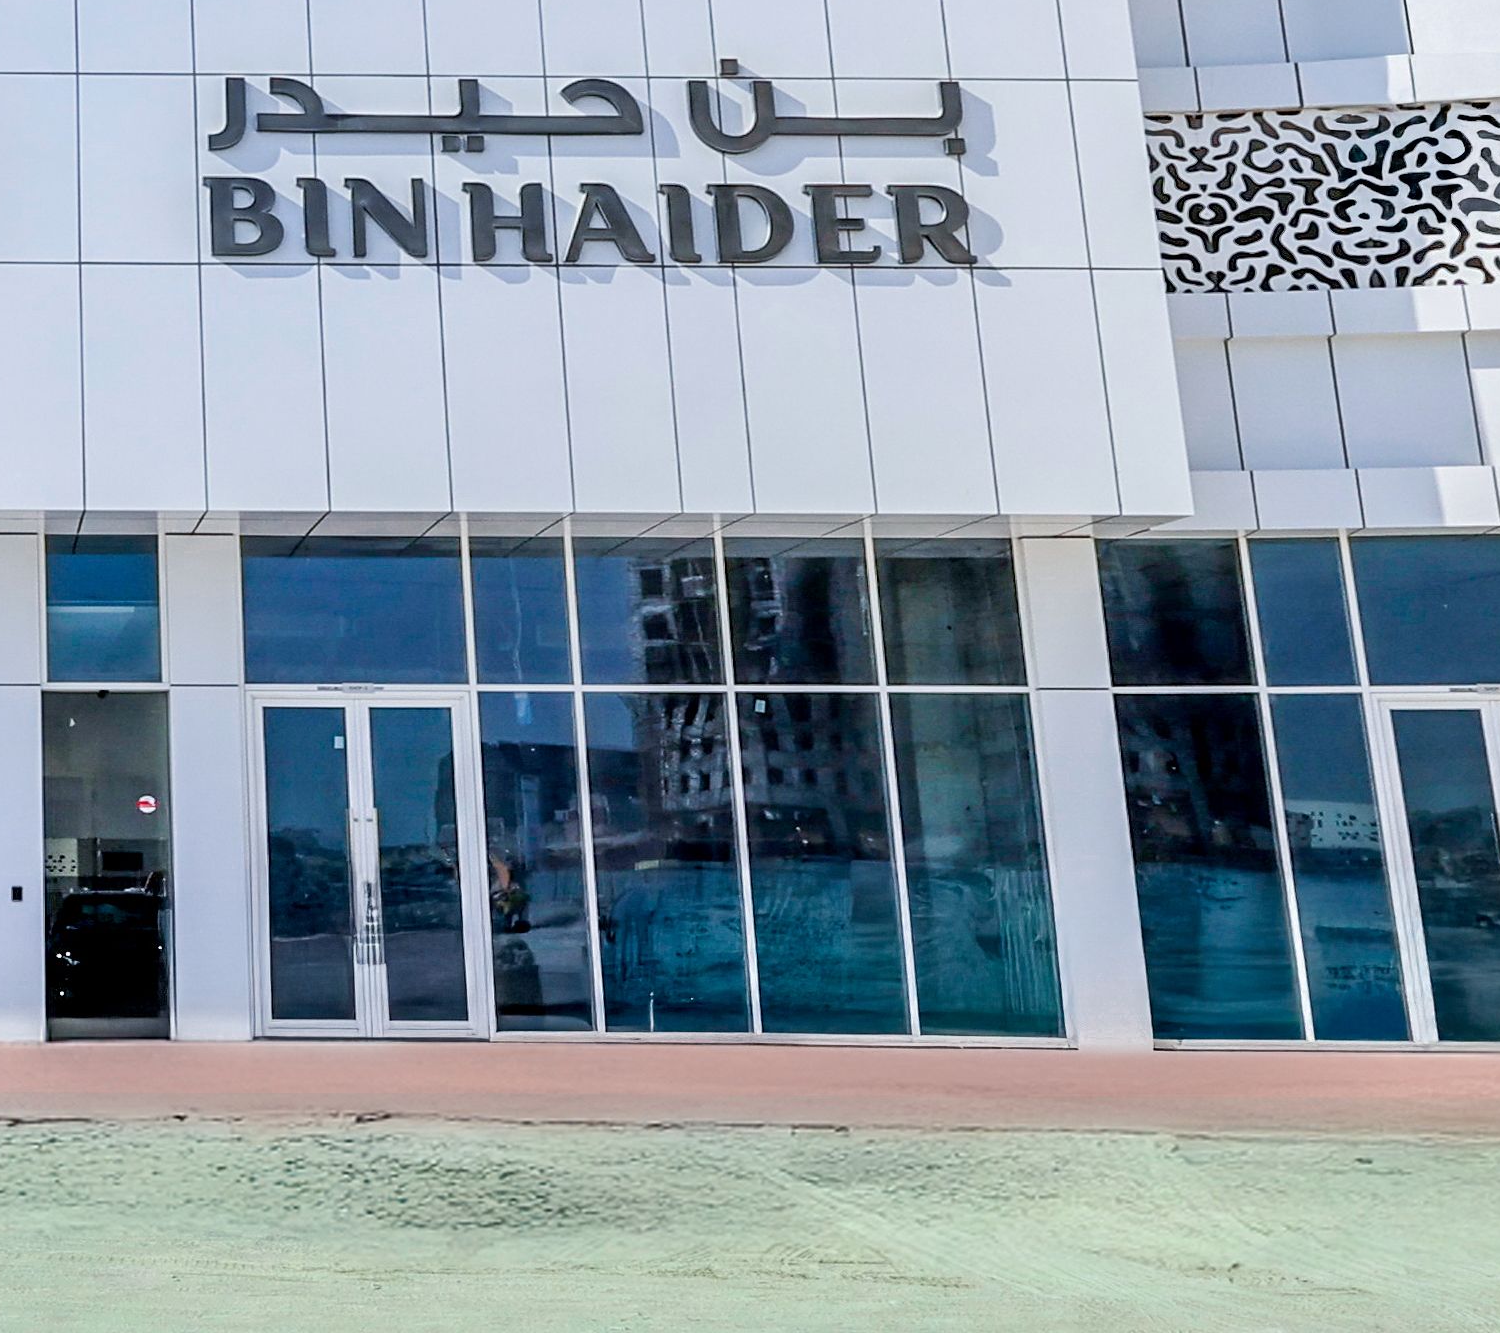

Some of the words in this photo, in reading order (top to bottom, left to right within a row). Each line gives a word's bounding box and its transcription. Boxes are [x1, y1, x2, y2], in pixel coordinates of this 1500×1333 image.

[208, 77, 644, 152] حيدر
[686, 58, 966, 156] بن
[203, 177, 428, 259] BIN
[461, 181, 978, 265] HAIDER
